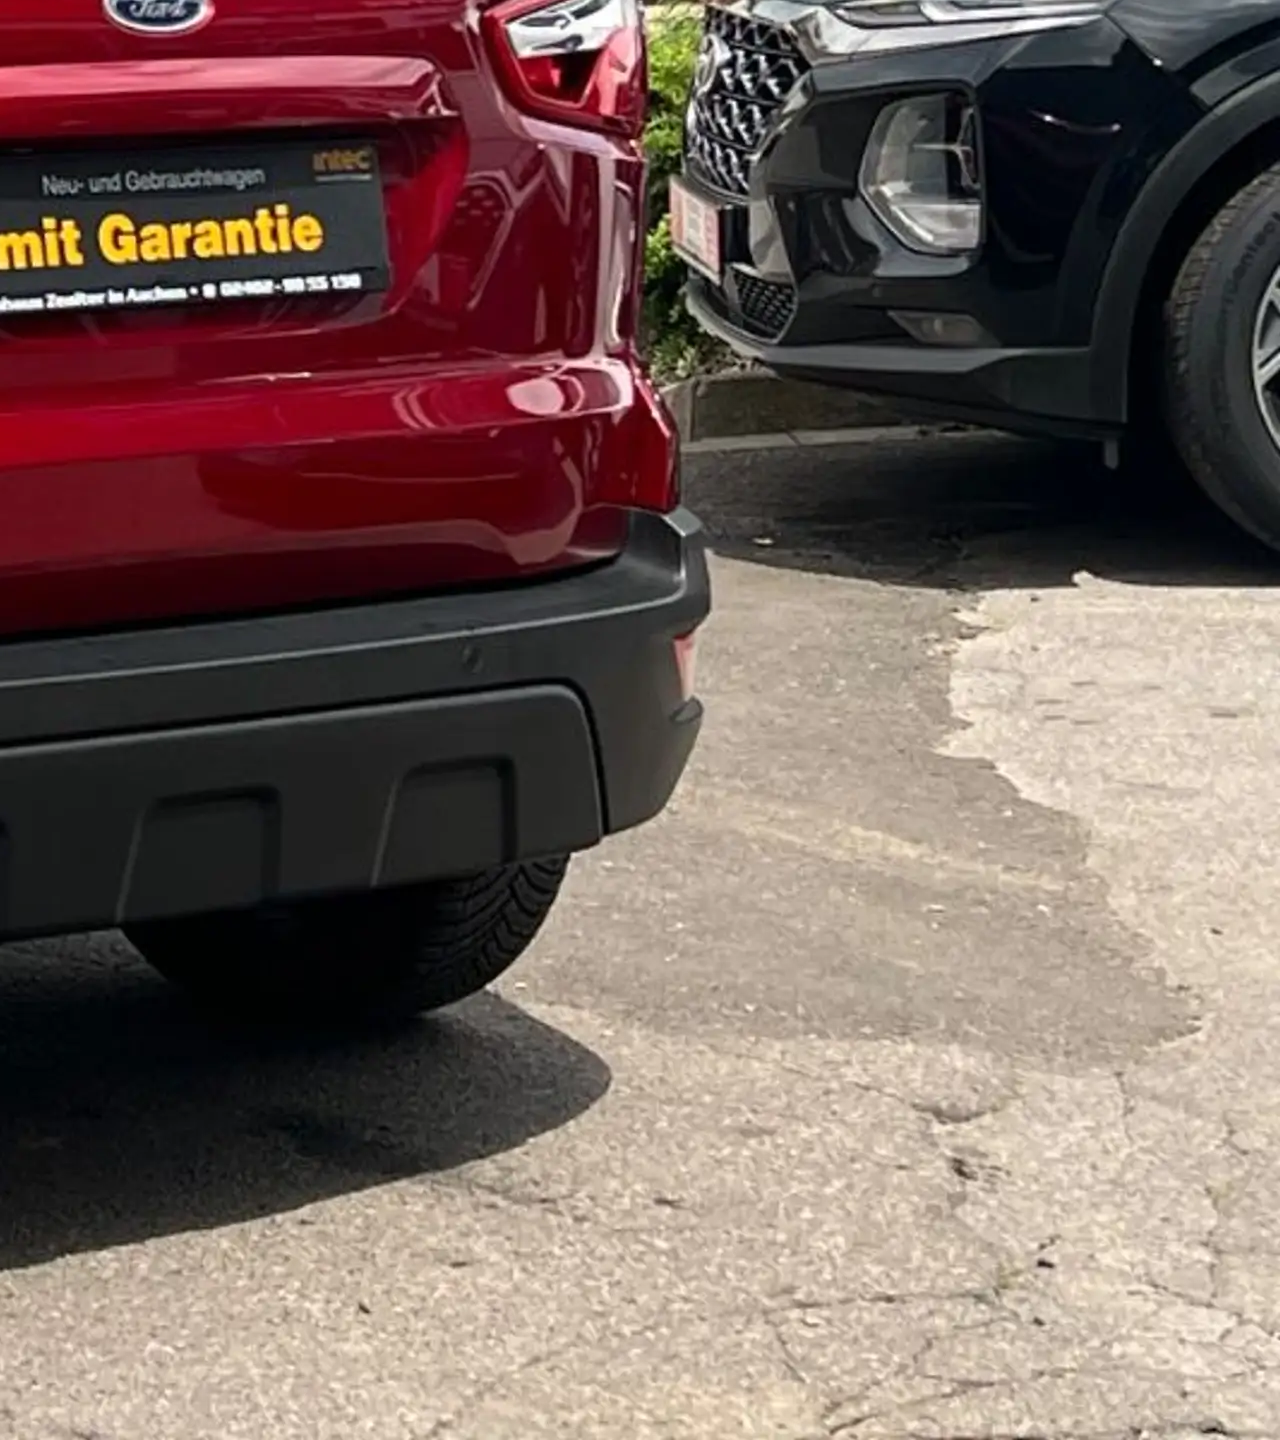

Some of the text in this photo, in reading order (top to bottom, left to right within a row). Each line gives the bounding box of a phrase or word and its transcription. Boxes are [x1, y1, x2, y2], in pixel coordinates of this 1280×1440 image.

[312, 146, 371, 171] intec
[42, 168, 266, 195] Neu- und Gebrauchtwagen
[96, 203, 325, 266] Garantie
